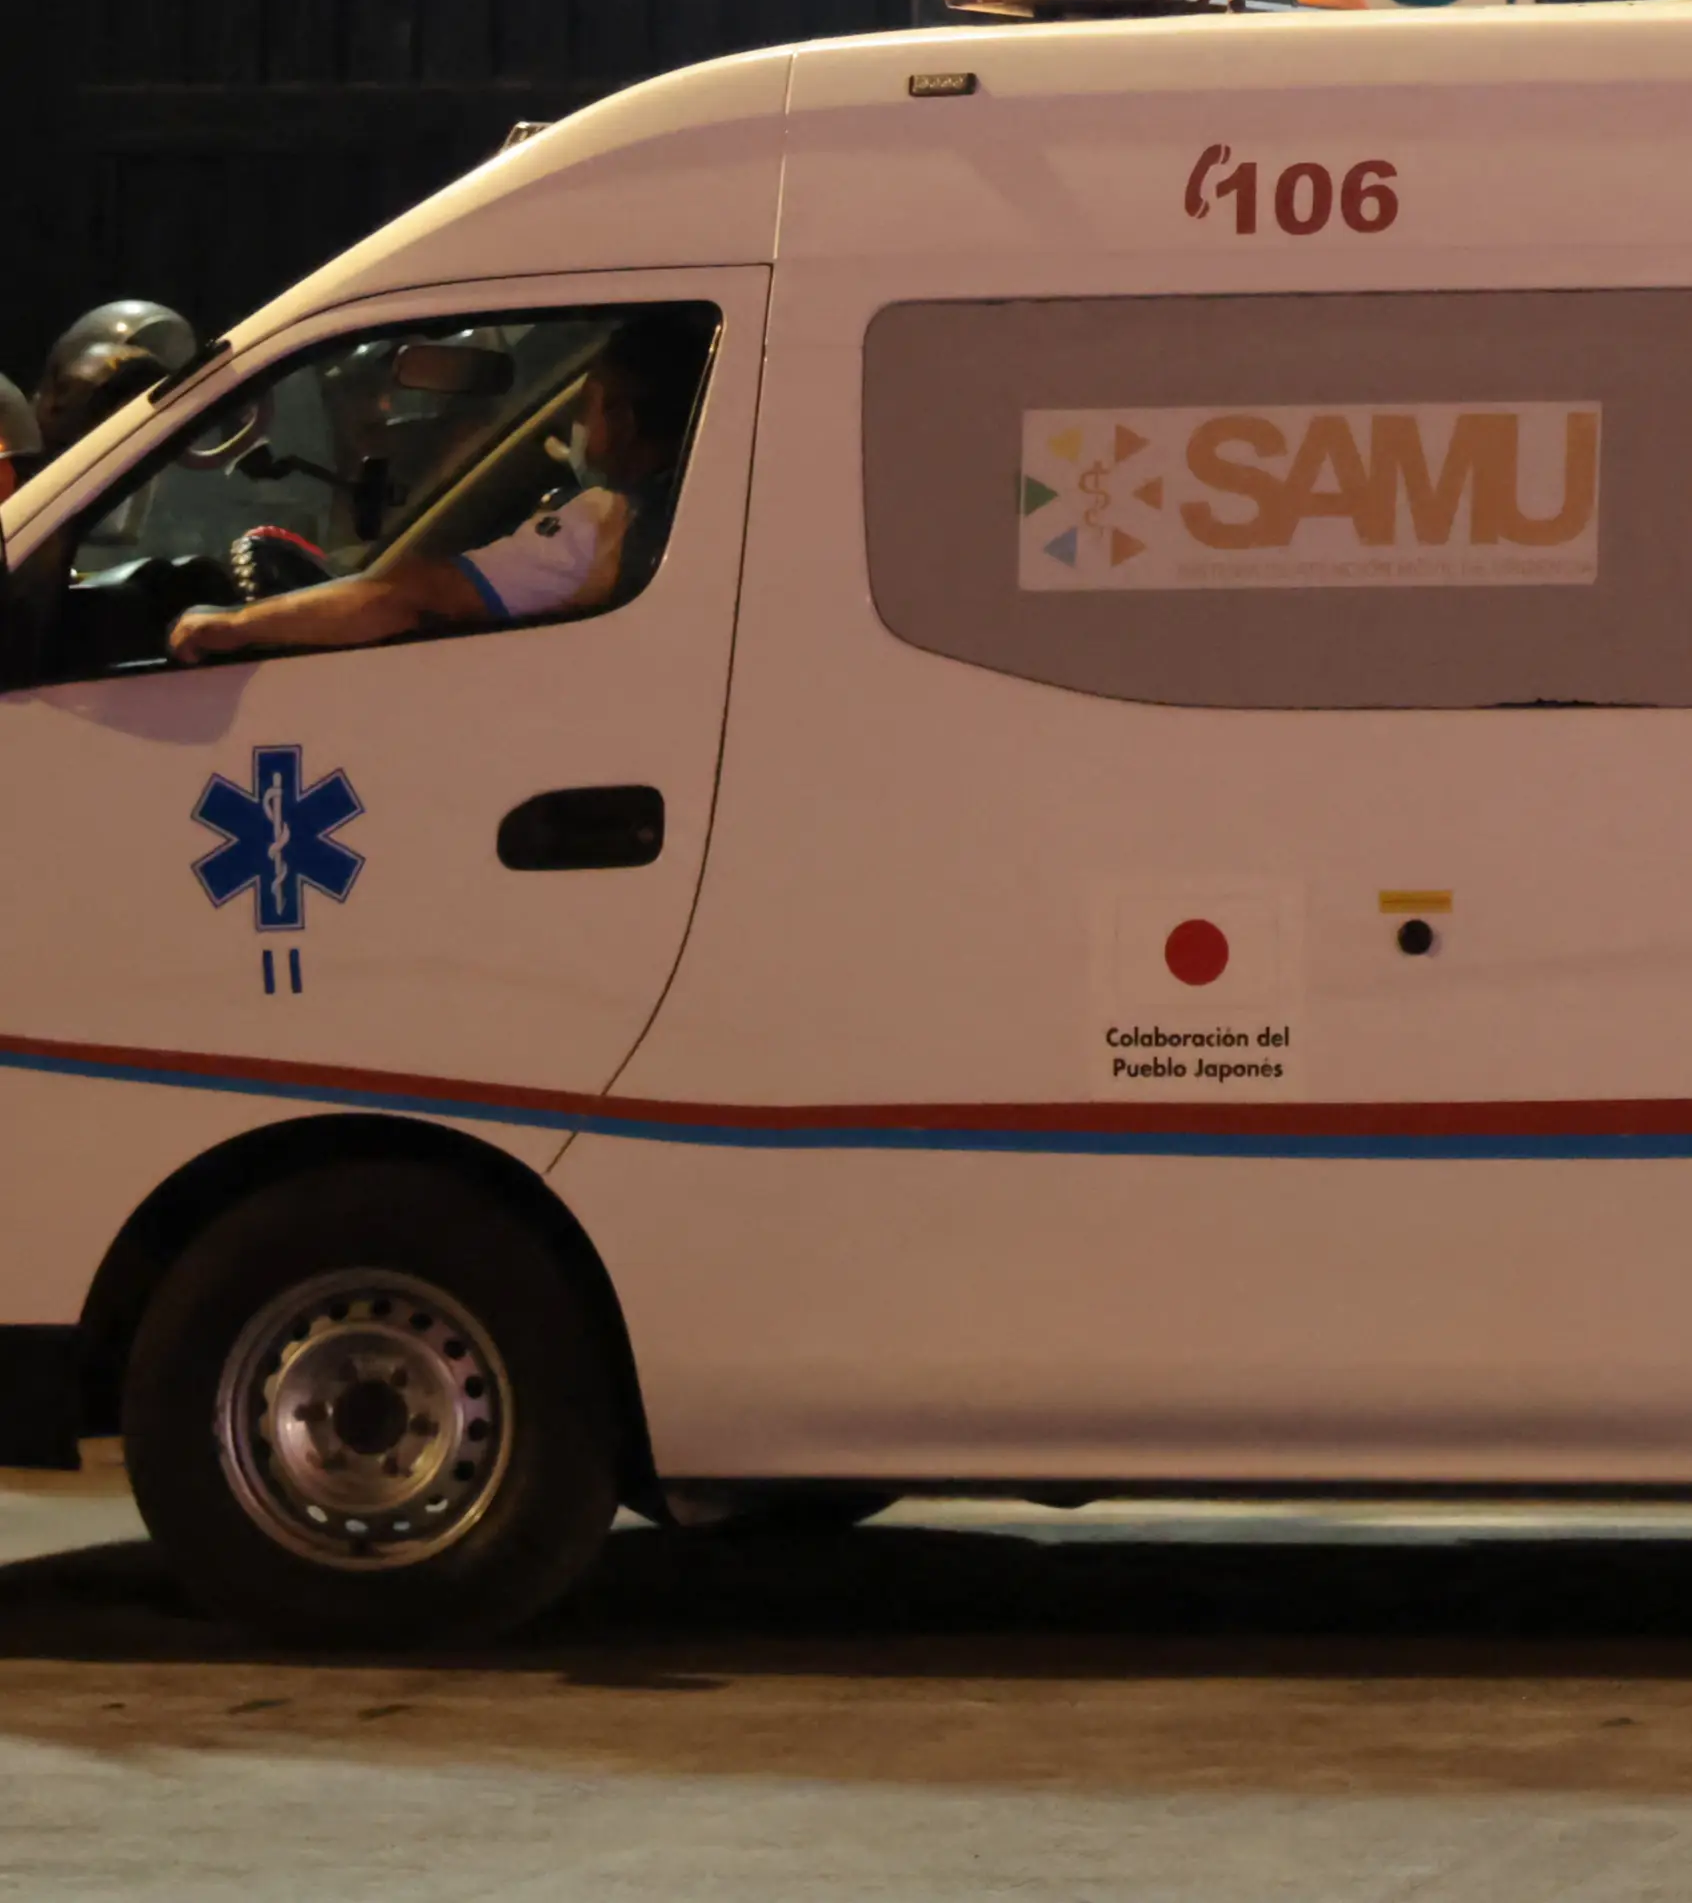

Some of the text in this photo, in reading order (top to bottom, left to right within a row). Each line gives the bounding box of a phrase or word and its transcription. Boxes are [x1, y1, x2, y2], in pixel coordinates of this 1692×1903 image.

[1216, 159, 1399, 236] 106
[1179, 412, 1598, 550] SAMU
[1106, 1026, 1290, 1048] Colaboración del
[1113, 1057, 1284, 1083] Pueblo Japonés
